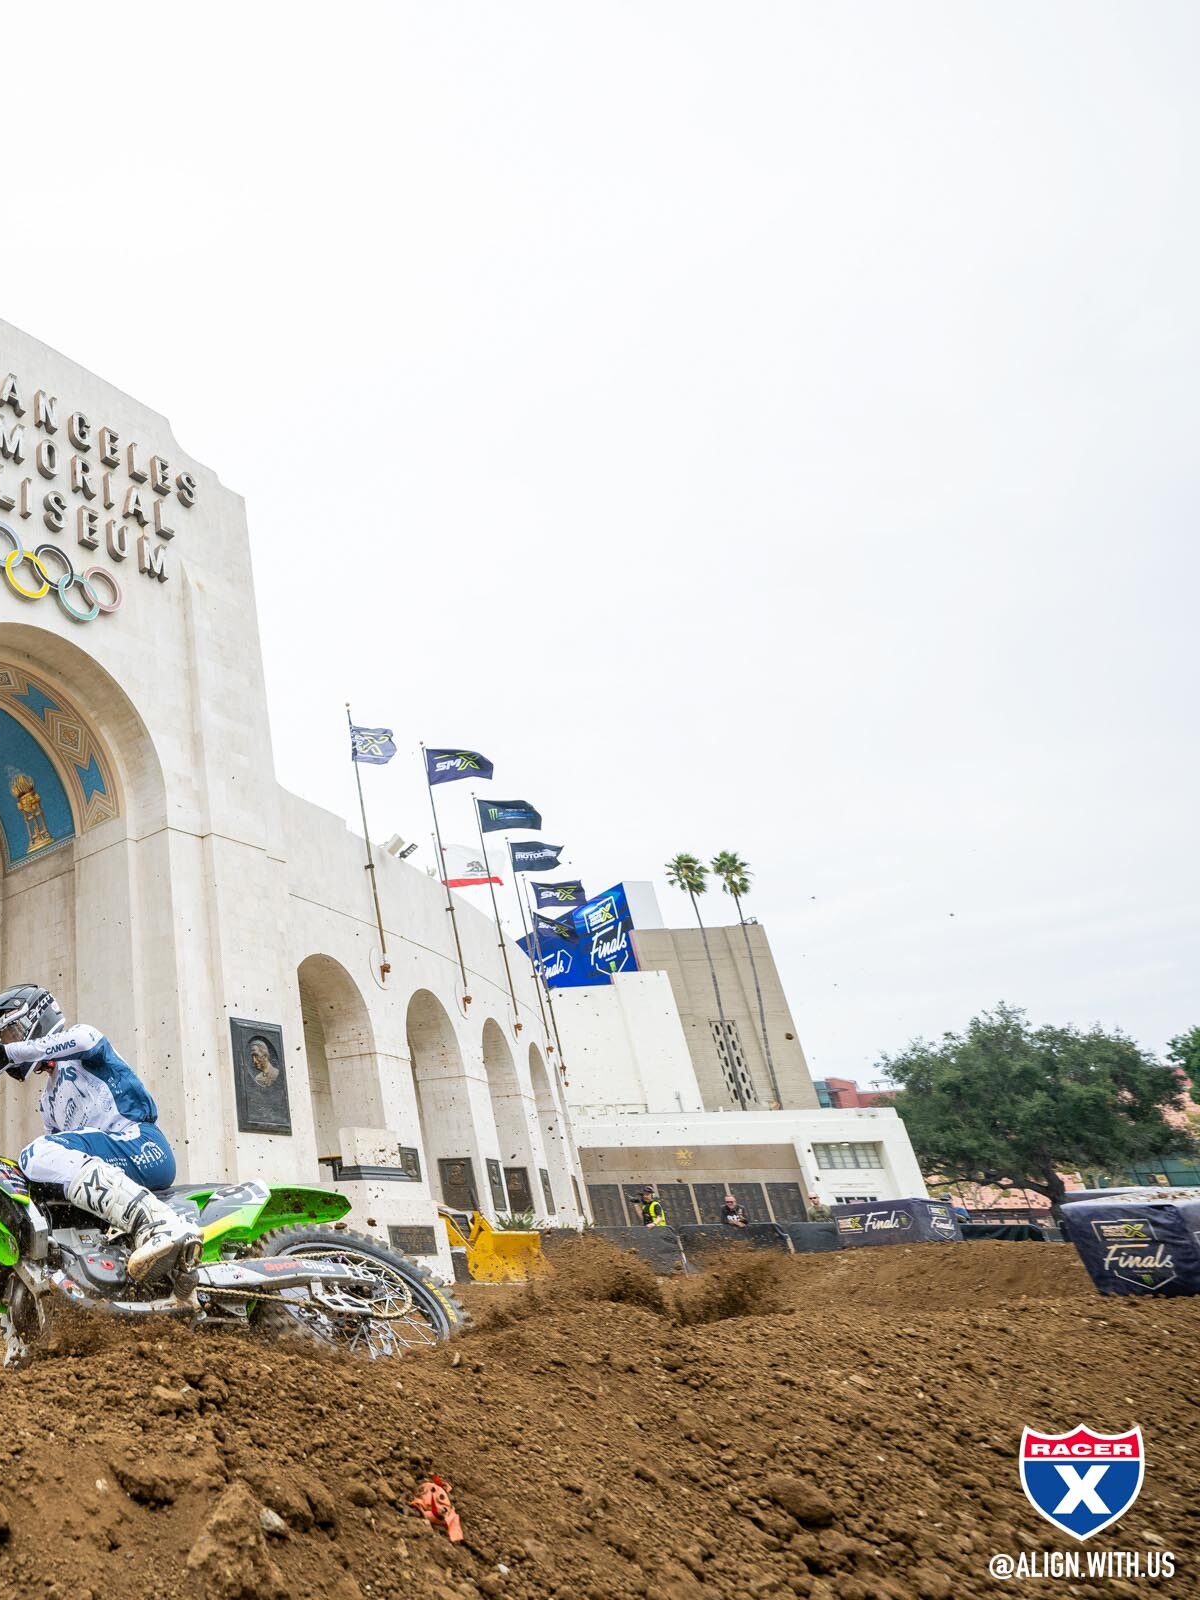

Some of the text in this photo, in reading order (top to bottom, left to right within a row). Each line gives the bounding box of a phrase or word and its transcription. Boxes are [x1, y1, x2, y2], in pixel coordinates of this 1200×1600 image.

[435, 754, 480, 772] SMX
[540, 887, 577, 901] SMX
[590, 921, 627, 966] Finals
[45, 1039, 77, 1056] CANVAS
[864, 1210, 900, 1233] Finals
[930, 1216, 955, 1231] Finals
[1103, 1243, 1175, 1271] Finals
